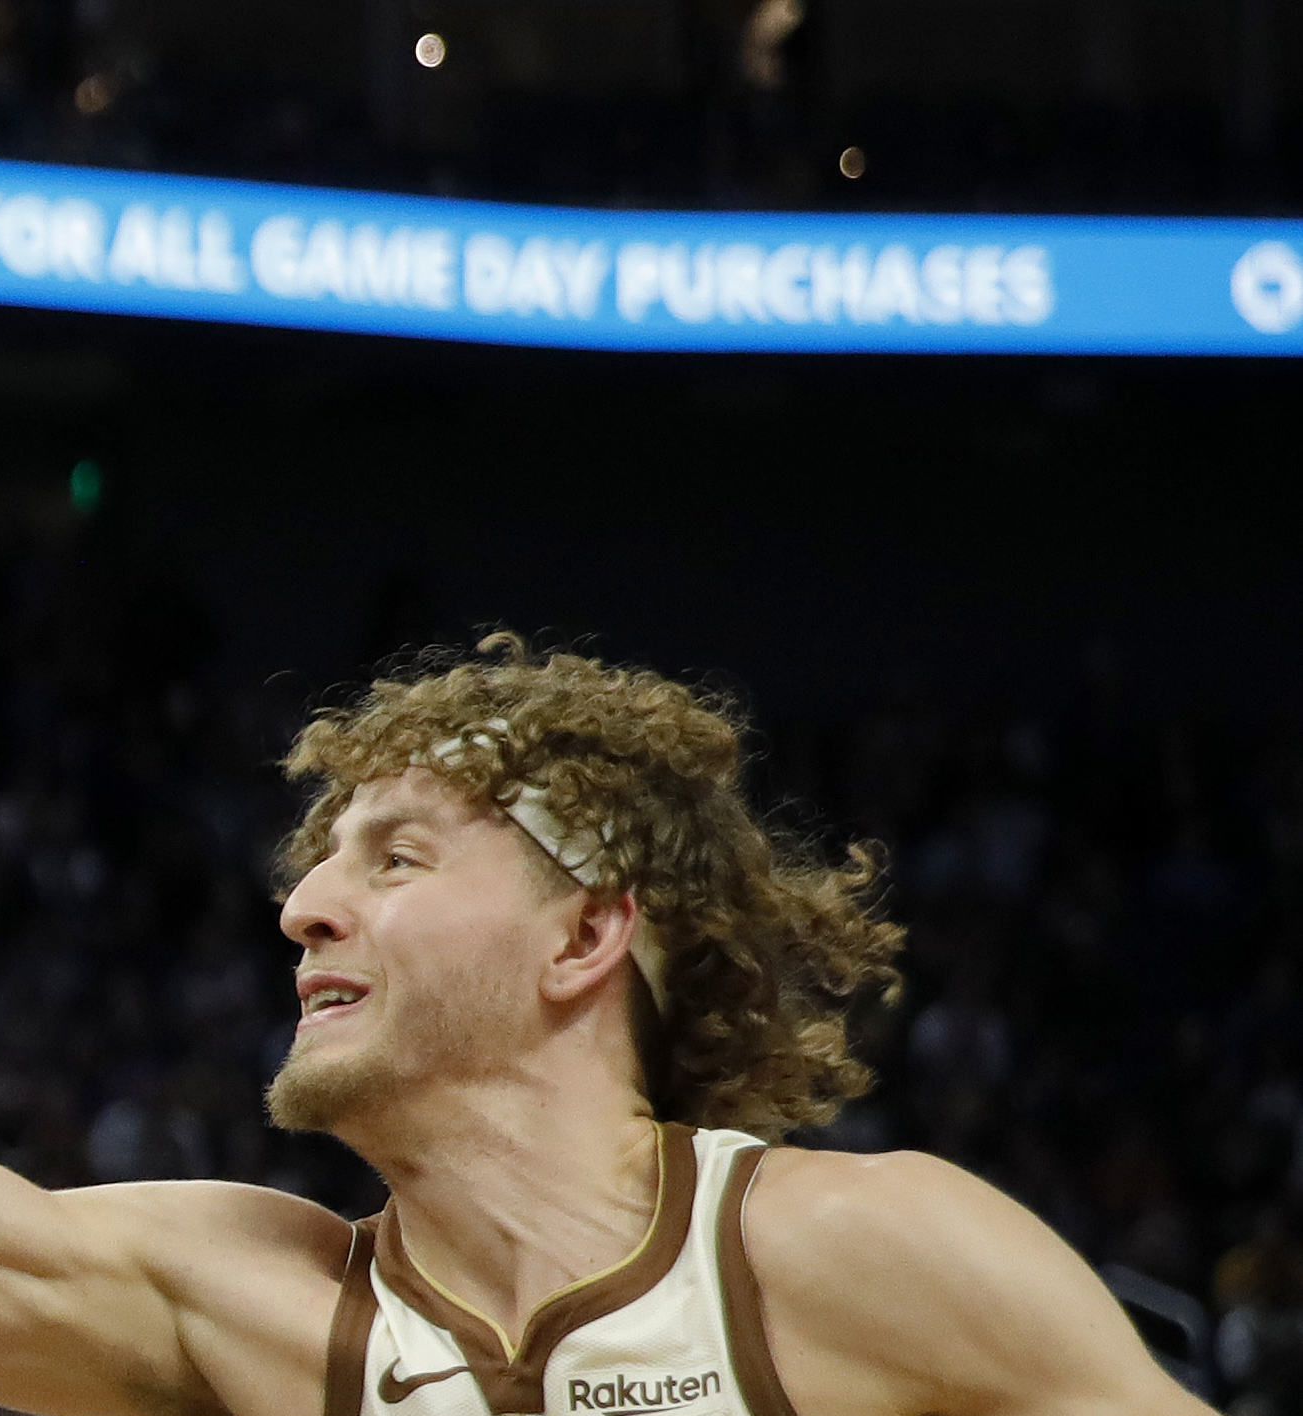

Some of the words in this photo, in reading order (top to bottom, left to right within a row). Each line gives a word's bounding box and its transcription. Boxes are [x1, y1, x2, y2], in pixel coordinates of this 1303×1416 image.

[107, 201, 246, 296] ALL
[250, 214, 457, 311] GAME
[463, 230, 609, 320] DAY
[616, 240, 1055, 326] PURCHASES
[568, 1369, 722, 1413] Rakuten
